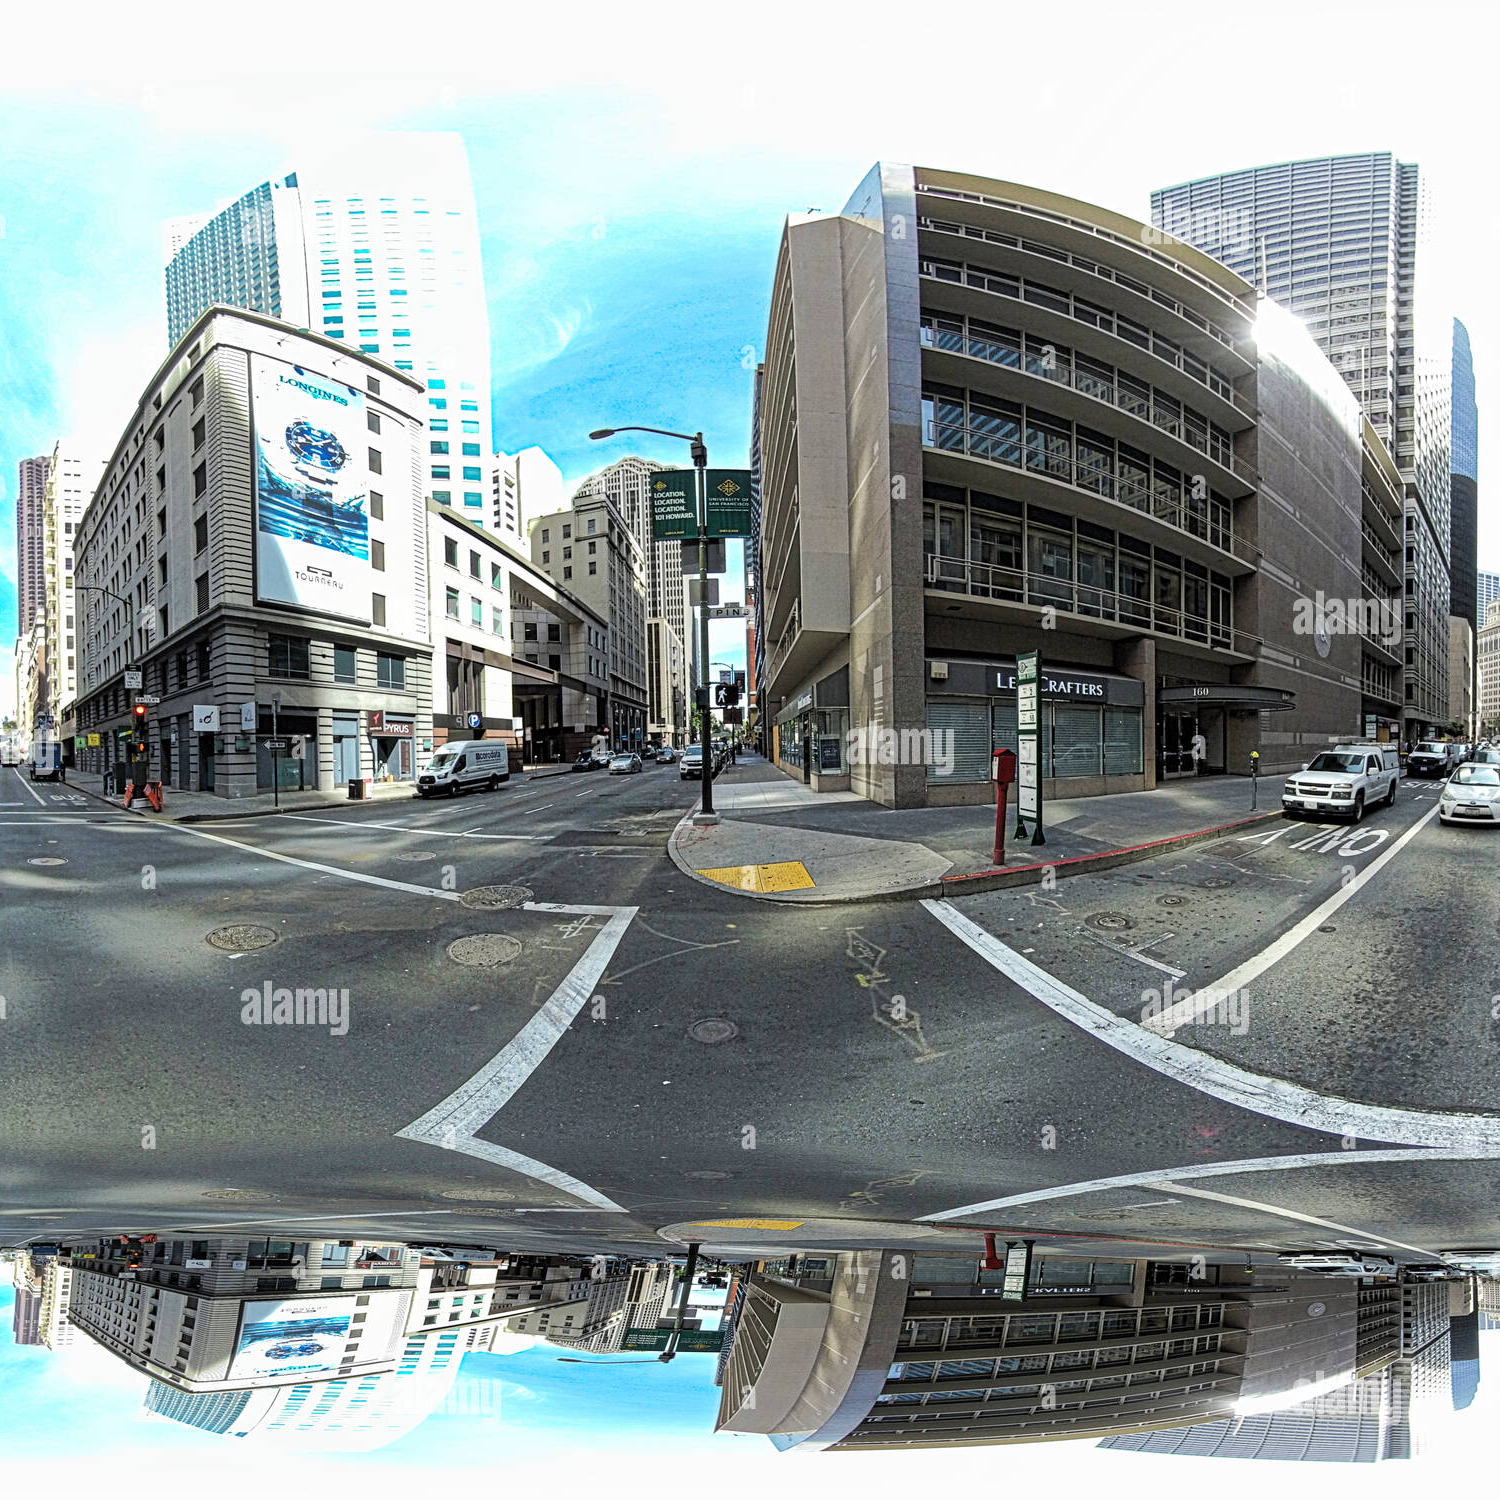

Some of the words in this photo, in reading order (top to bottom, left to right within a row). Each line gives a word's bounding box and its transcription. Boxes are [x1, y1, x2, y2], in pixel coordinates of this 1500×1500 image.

[279, 375, 349, 407] LONGINES
[666, 512, 695, 520] HOWARD.
[997, 672, 1103, 696] LECRAFTERS
[1193, 688, 1209, 696] 160
[384, 723, 409, 734] PYRUS
